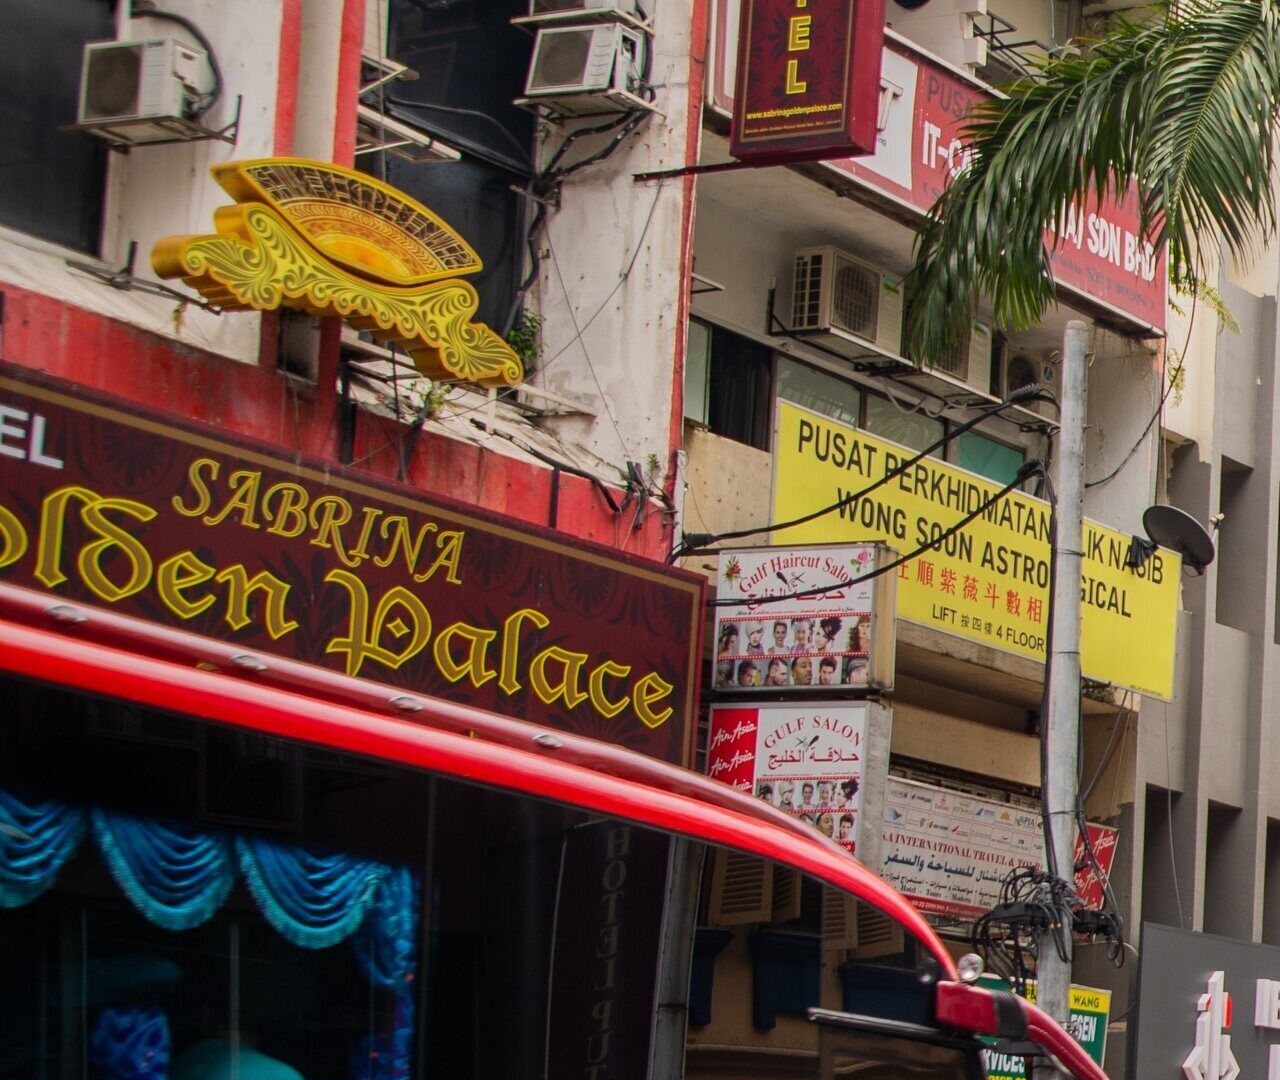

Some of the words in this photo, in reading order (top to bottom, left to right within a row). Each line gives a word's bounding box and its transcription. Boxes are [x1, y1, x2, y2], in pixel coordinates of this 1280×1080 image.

[798, 418, 878, 480] PUSAT
[171, 457, 465, 585] SABRINA
[836, 486, 908, 542] WONG
[915, 513, 974, 563] SOON
[739, 562, 769, 593] Gulf
[770, 553, 821, 574] Haircut
[325, 567, 675, 730] Palace
[931, 603, 958, 626] LIFT
[996, 625, 1003, 640] 4
[1005, 627, 1045, 653] FLOOR
[764, 716, 806, 749] GULF
[812, 715, 864, 748] SALON
[893, 832, 972, 864] INTERNATIONAL
[973, 849, 1007, 869] TRAVEL
[1073, 993, 1100, 1009] WANG
